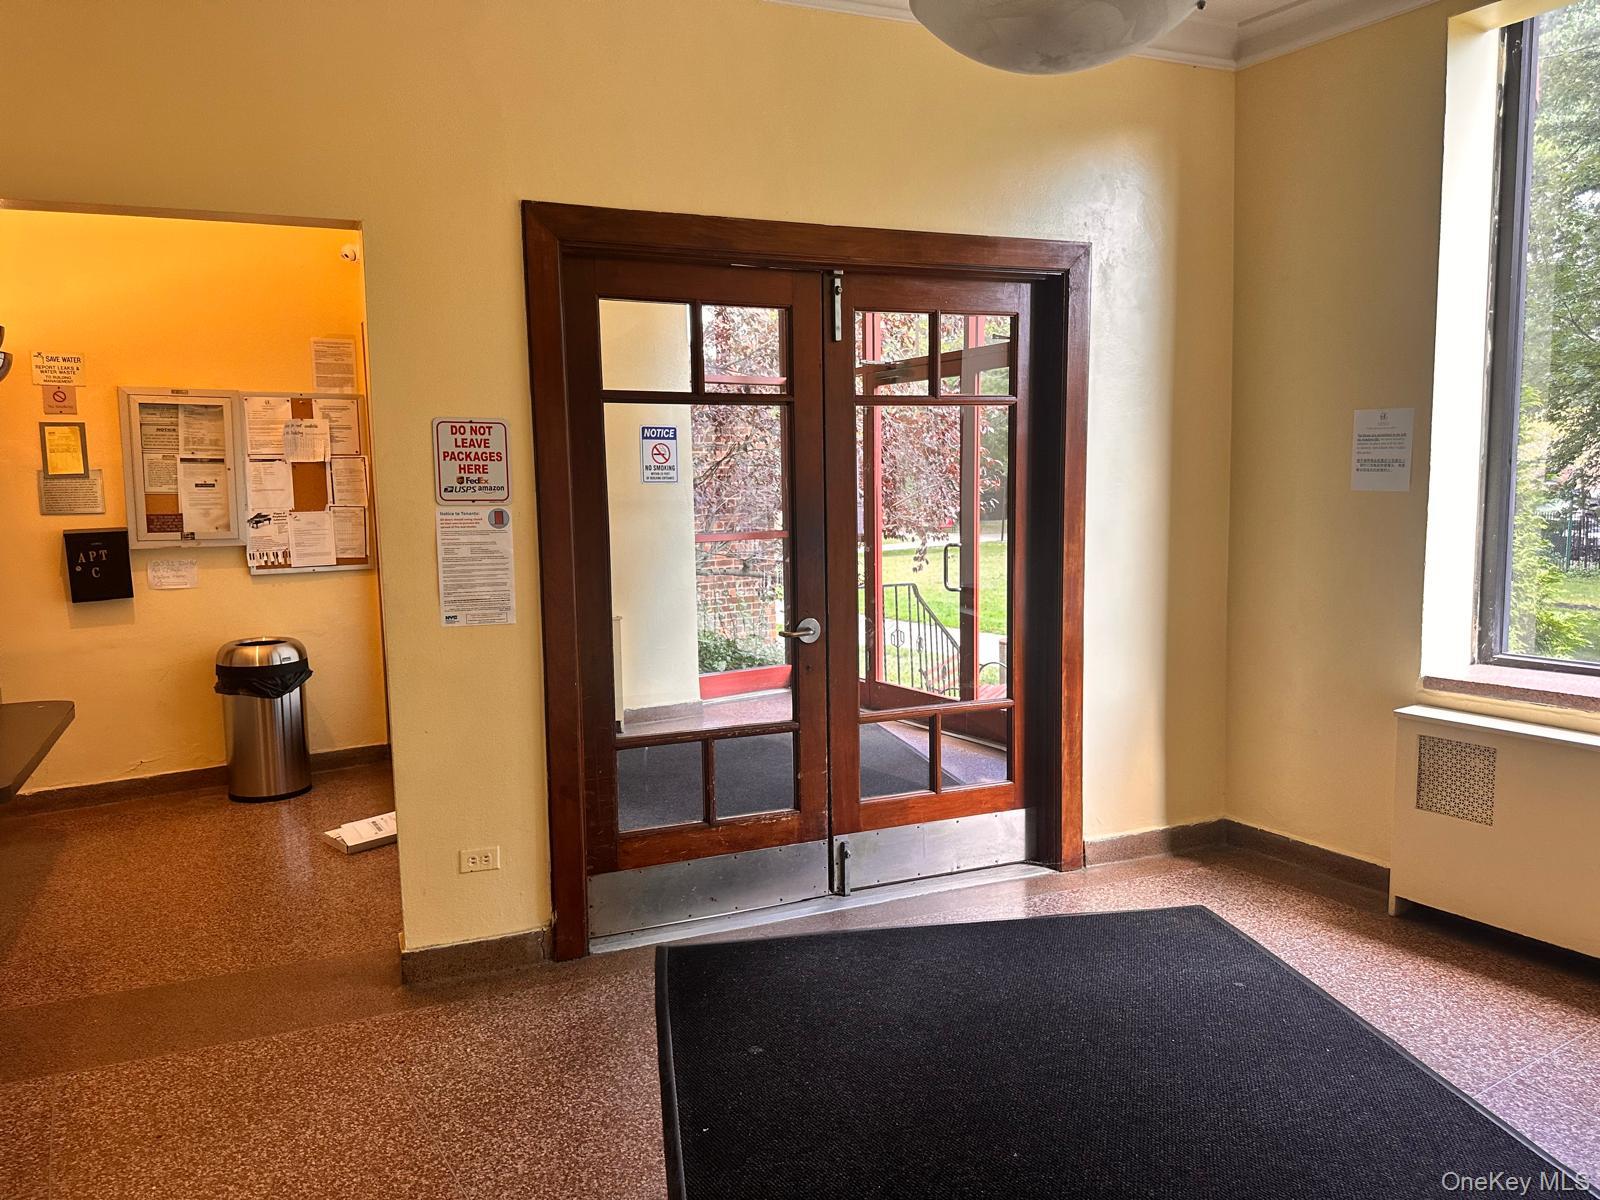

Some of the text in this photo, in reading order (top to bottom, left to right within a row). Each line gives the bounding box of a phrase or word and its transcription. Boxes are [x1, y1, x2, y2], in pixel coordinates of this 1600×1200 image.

[450, 425, 493, 436] DO NOT
[643, 428, 675, 437] NOTICE
[454, 438, 491, 449] LEAVE
[442, 451, 503, 462] PACKAGES
[458, 464, 489, 475] HERE
[465, 476, 489, 485] FedEx
[454, 485, 477, 493] USPS
[78, 549, 108, 563] APT
[91, 566, 101, 578] C
